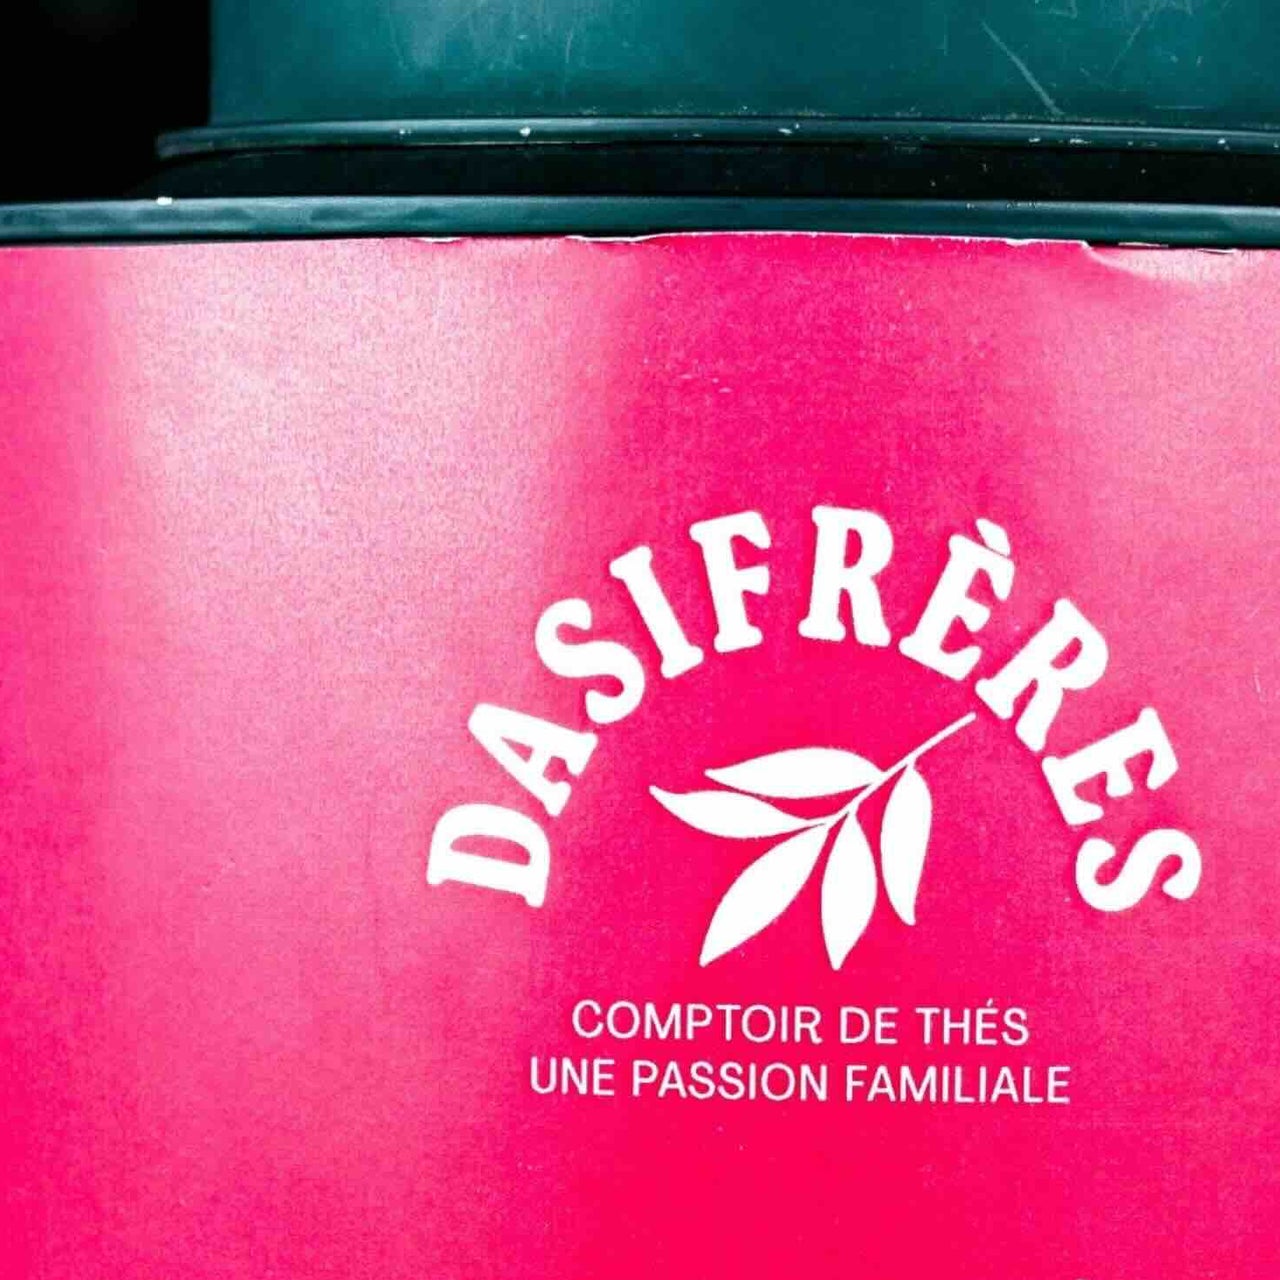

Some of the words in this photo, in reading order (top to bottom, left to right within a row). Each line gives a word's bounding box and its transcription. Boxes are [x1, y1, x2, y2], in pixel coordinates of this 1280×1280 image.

[572, 999, 822, 1044] COMPTOIR
[840, 1006, 898, 1044] DE
[915, 1000, 1029, 1046] THÉS
[530, 1056, 615, 1096] UNE
[632, 1059, 827, 1101] PASSION
[846, 1065, 1070, 1103] FAMILIALE
